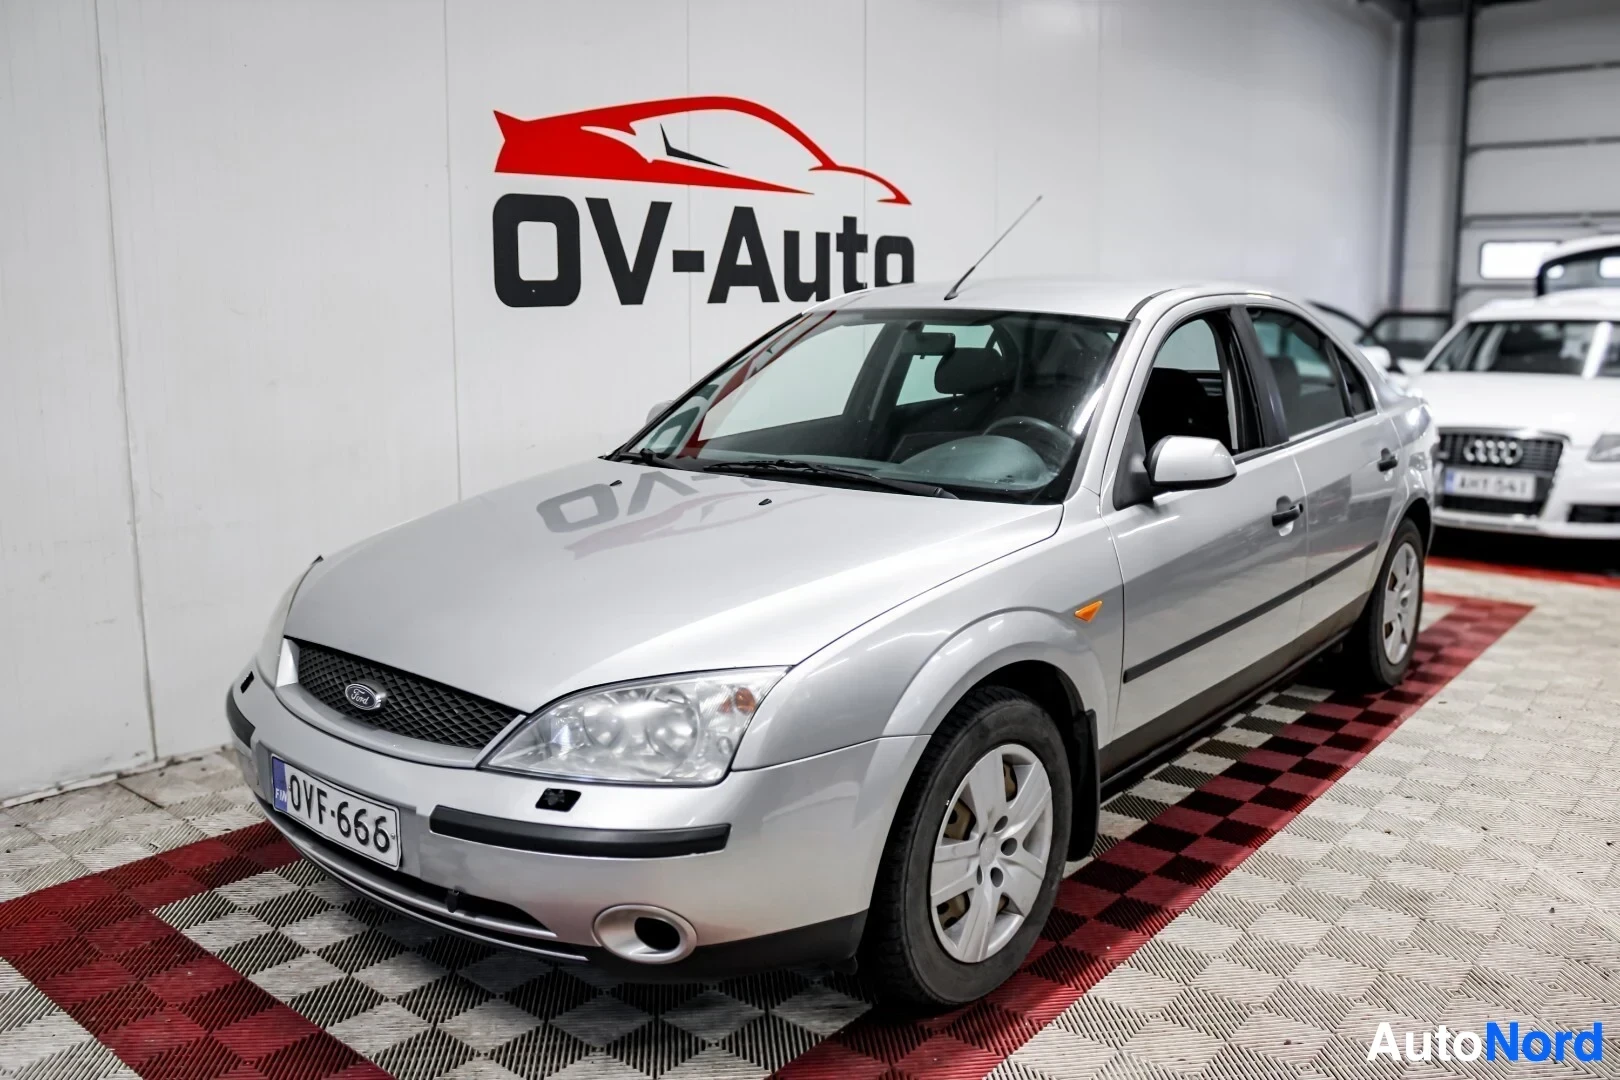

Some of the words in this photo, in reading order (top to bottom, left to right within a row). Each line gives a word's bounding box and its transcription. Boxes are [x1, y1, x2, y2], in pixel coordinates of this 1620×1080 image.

[493, 193, 915, 307] OV-Auto
[351, 689, 370, 704] Ford
[275, 787, 288, 802] FIN
[290, 774, 390, 853] OVF-666
